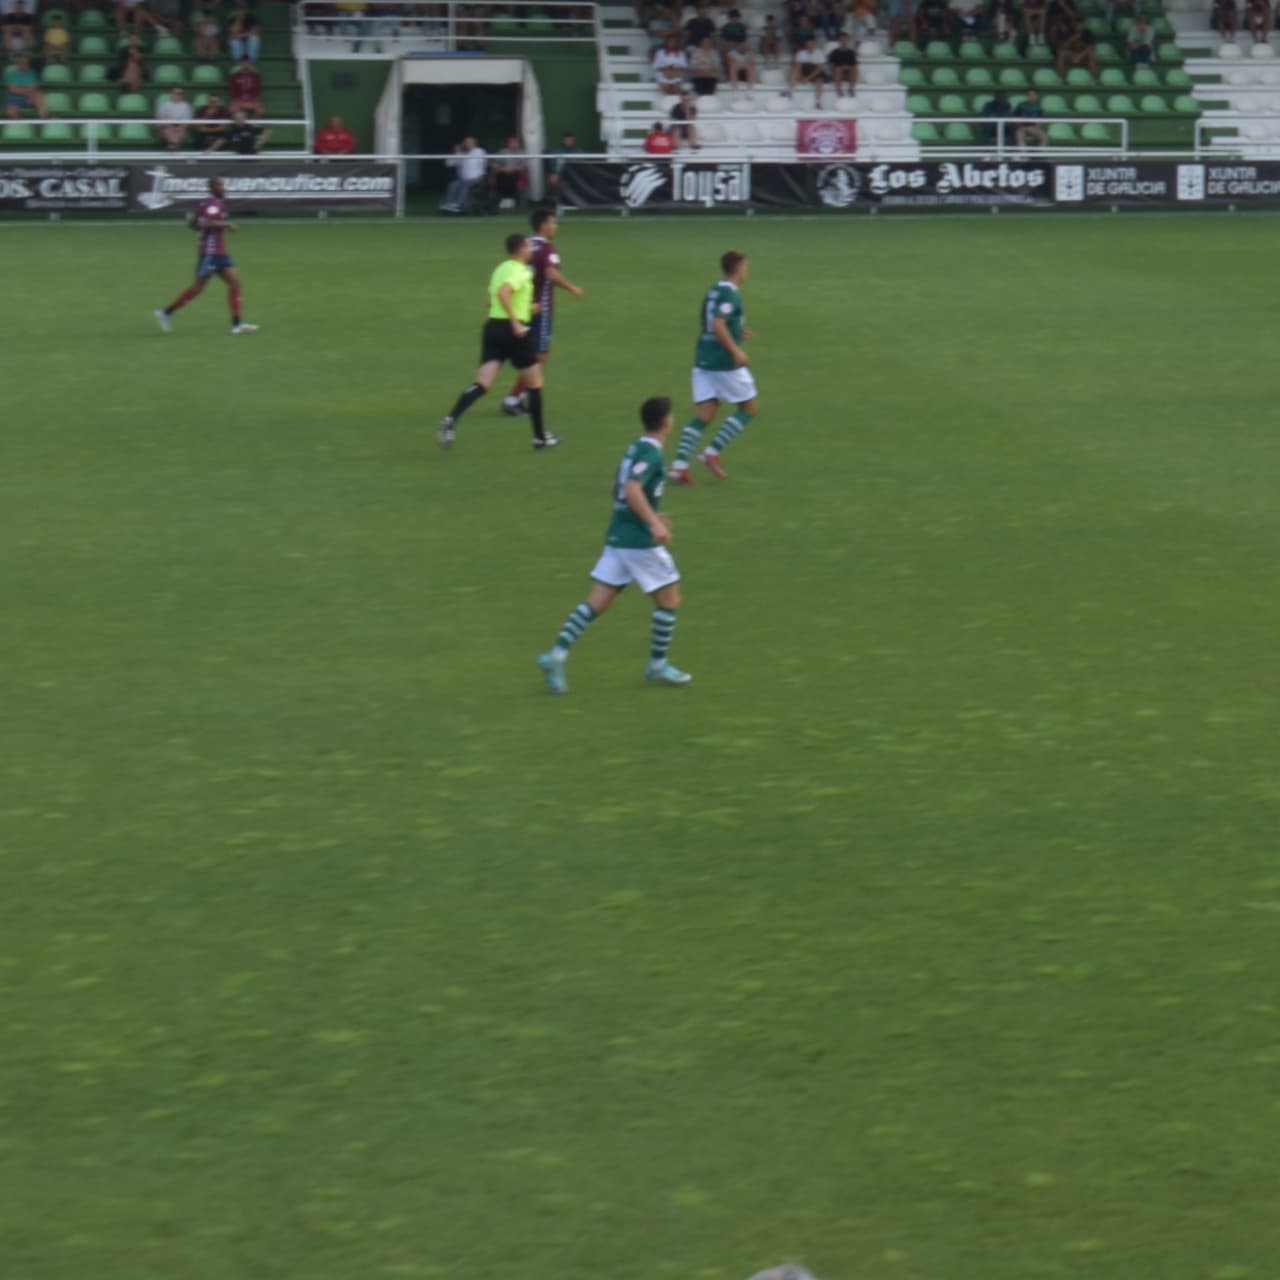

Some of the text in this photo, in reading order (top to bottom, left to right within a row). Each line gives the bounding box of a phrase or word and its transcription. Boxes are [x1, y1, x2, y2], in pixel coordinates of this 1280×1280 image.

[868, 163, 1046, 194] Los Abetos
[1087, 167, 1137, 180] XUNTA
[1208, 166, 1257, 180] XUNTA
[39, 177, 128, 198] CASAL
[163, 175, 394, 193] masuenautica.com
[1086, 181, 1167, 195] DE GALICIA
[1207, 180, 1225, 194] DE
